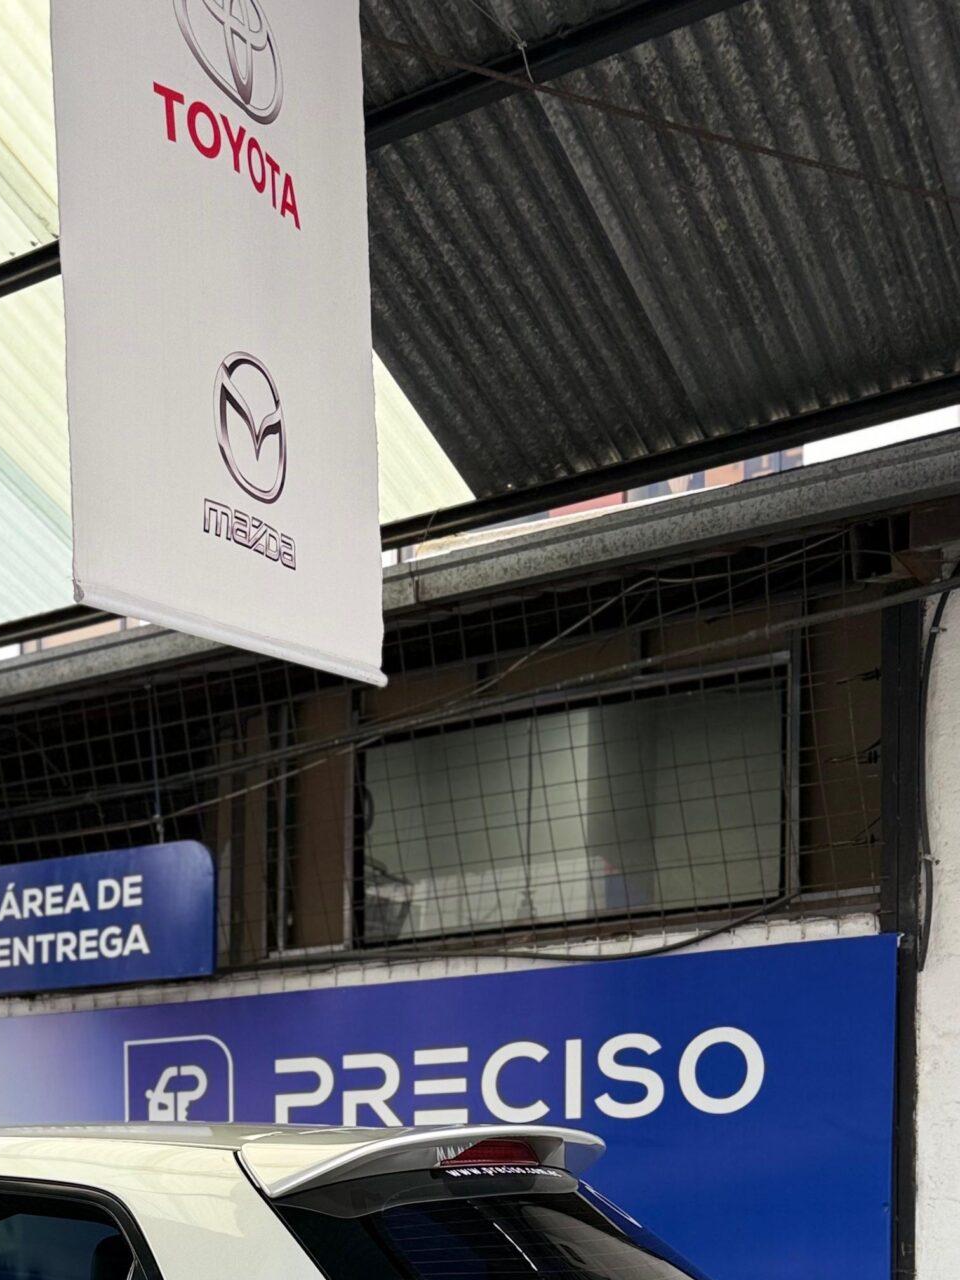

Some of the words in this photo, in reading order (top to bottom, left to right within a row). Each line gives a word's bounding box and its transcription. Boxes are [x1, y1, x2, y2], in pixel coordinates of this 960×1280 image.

[152, 81, 301, 230] TOYOTA
[97, 875, 143, 911] DE
[273, 1026, 765, 1127] PRECISO
